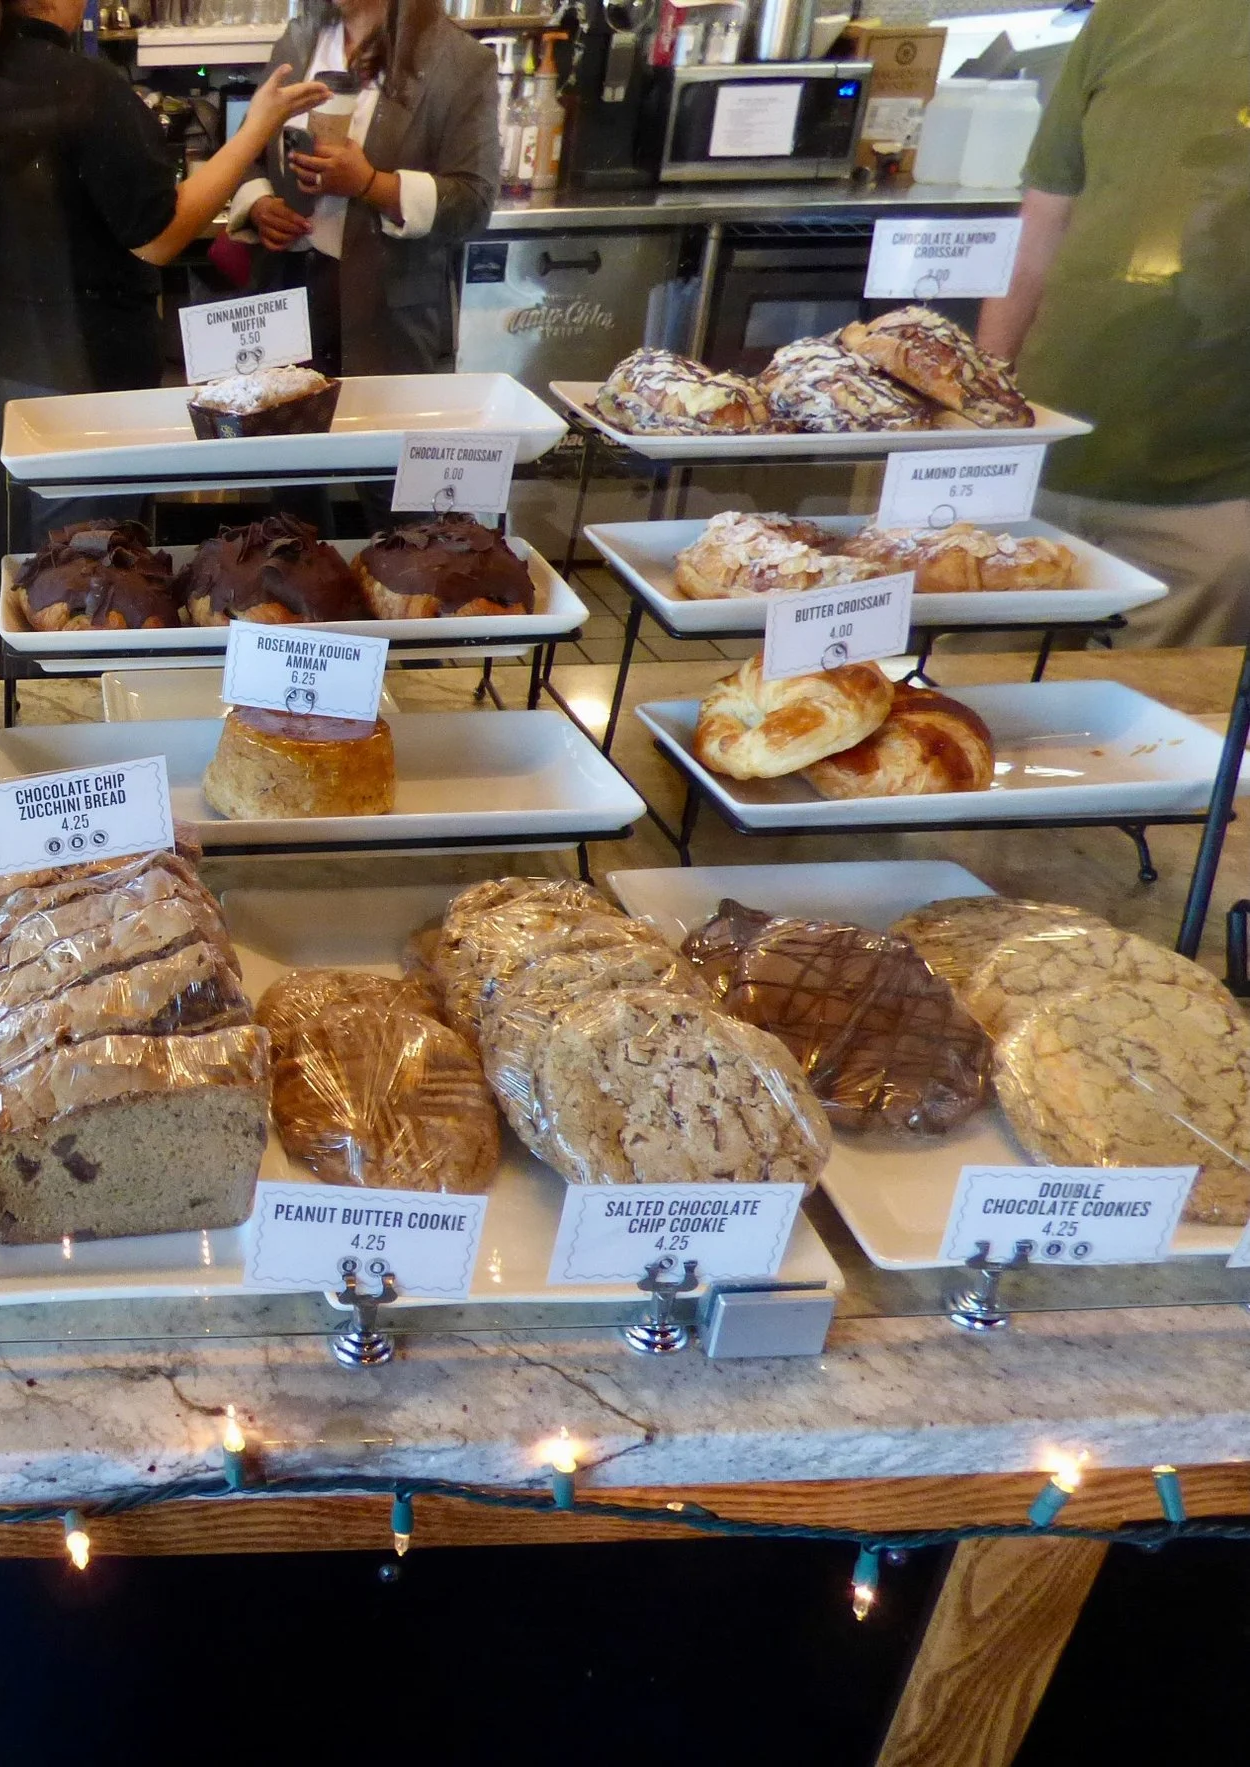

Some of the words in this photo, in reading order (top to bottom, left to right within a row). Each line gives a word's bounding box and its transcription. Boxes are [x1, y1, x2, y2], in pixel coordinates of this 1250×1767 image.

[892, 232, 952, 245] CHOCOLATE
[954, 232, 996, 244] ALMOND
[914, 246, 972, 258] CROISSANT
[207, 303, 255, 325] CINNAMON
[258, 298, 288, 315] CREME
[231, 316, 266, 334] MUFFIN
[240, 331, 261, 346] 5.50
[410, 446, 455, 460] CHOCOLATE
[456, 448, 503, 462] CROISSANT
[443, 467, 464, 480] 6.00
[911, 466, 956, 480] ALMOND
[959, 463, 1019, 479] CROISSANT
[949, 484, 974, 497] 6.75
[795, 604, 834, 623] BUTTER
[836, 592, 893, 615] CROISSANT
[829, 623, 853, 639] 4.00
[257, 636, 317, 657] ROSEMARY
[318, 644, 361, 661] KOUIGN
[285, 655, 328, 672] AMMAN
[291, 670, 316, 686] 6.25
[15, 778, 90, 805] CHOCOLATE
[94, 773, 126, 792] CHIP
[18, 797, 81, 821] ZUCCHINI
[85, 789, 126, 810] BREAD
[61, 813, 90, 832] 4.25
[1038, 1182, 1105, 1199] DOUBLE
[604, 1200, 665, 1217] SALTED
[667, 1200, 761, 1216] CHOCOLATE
[982, 1198, 1076, 1216] CHOCOLATE
[1081, 1201, 1152, 1217] COOKIES
[274, 1203, 338, 1224] PEANUT
[341, 1208, 403, 1228] BUTTER
[407, 1212, 467, 1232] COOKIE
[627, 1218, 667, 1234] CHIP
[669, 1217, 728, 1233] COOKIE
[1041, 1221, 1079, 1237] 4.25
[350, 1233, 387, 1251] 4.25
[654, 1235, 691, 1251] 4.25
